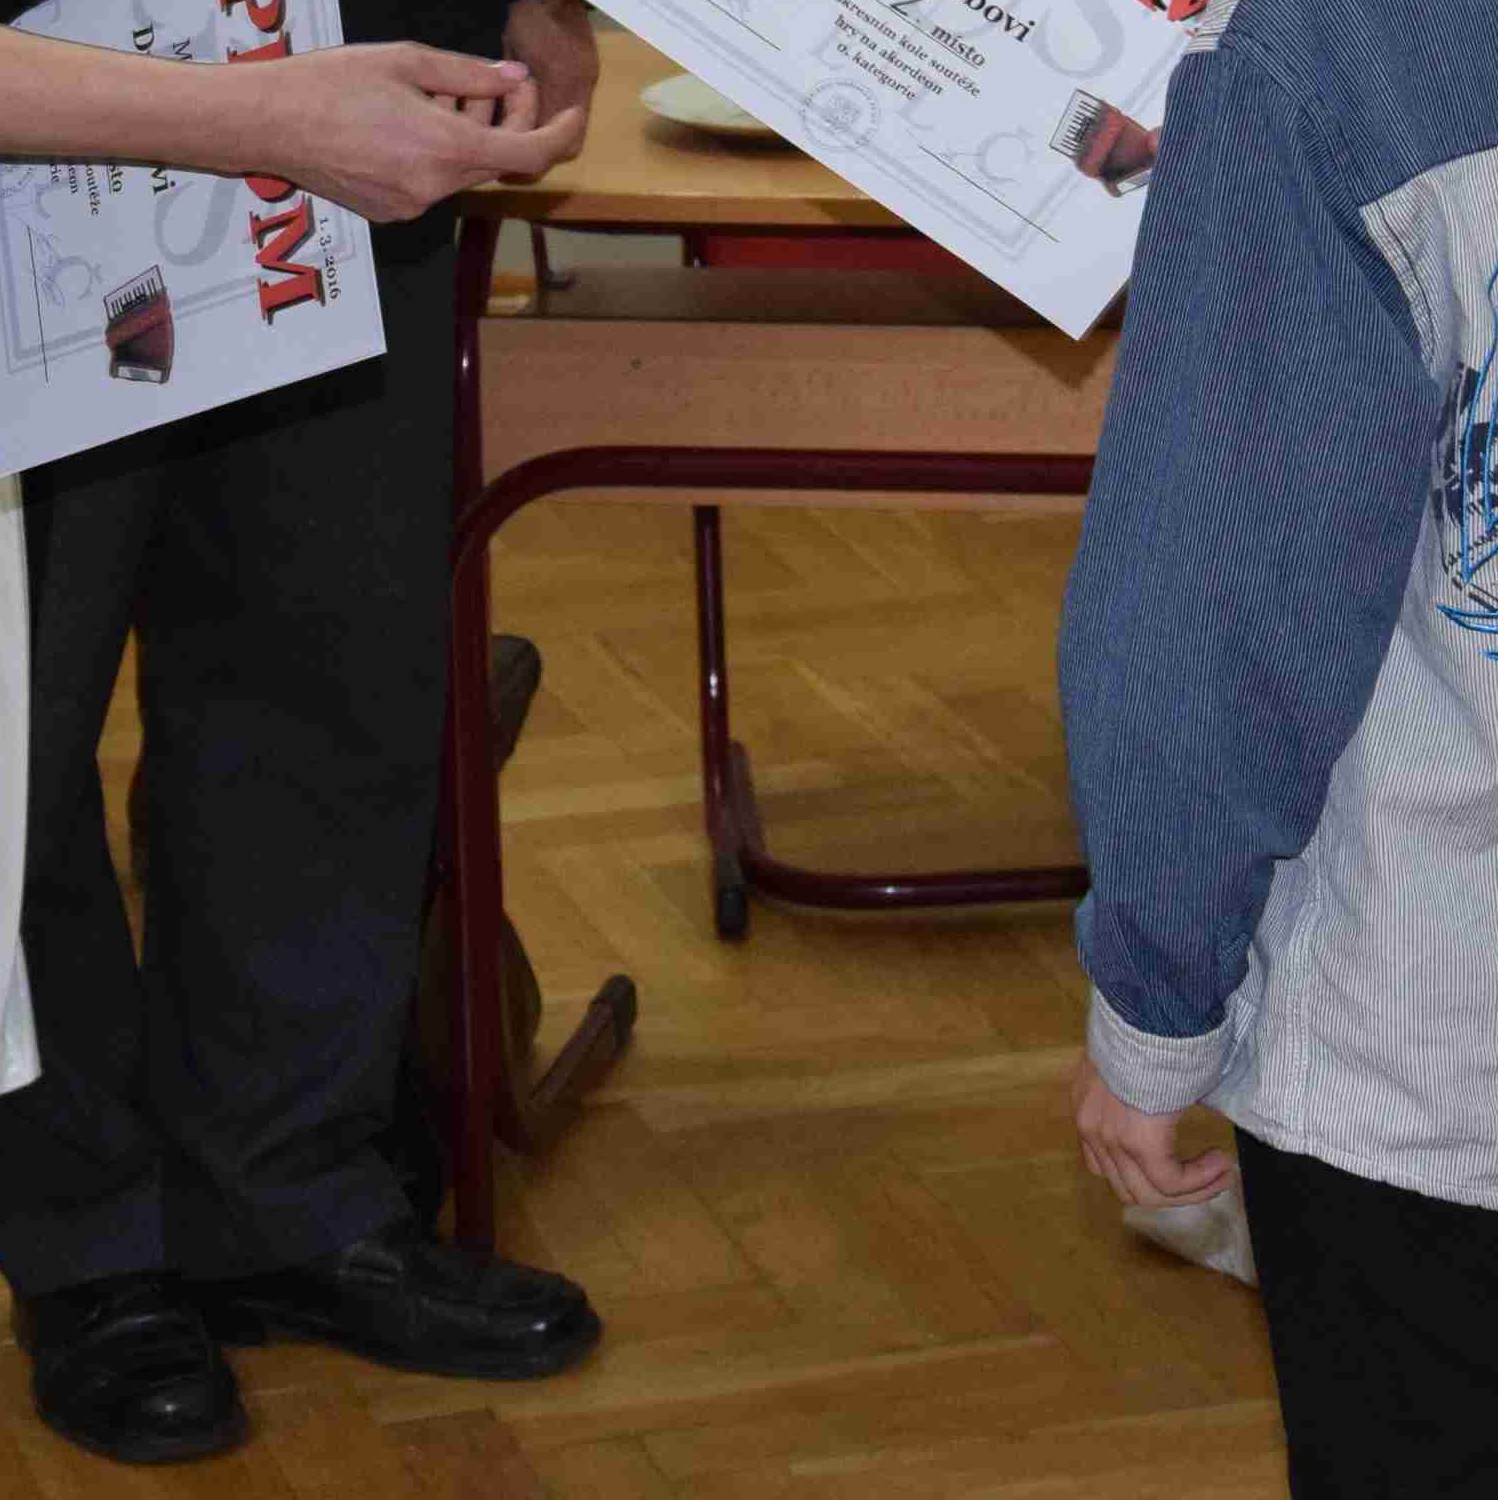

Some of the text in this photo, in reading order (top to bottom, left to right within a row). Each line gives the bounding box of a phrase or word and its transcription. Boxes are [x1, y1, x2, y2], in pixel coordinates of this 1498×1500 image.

[859, 34, 879, 52] na
[877, 46, 945, 97] akordeon
[898, 34, 930, 62] kole
[929, 24, 987, 69] místo
[851, 50, 919, 102] kategorie
[324, 257, 342, 301] 2016
